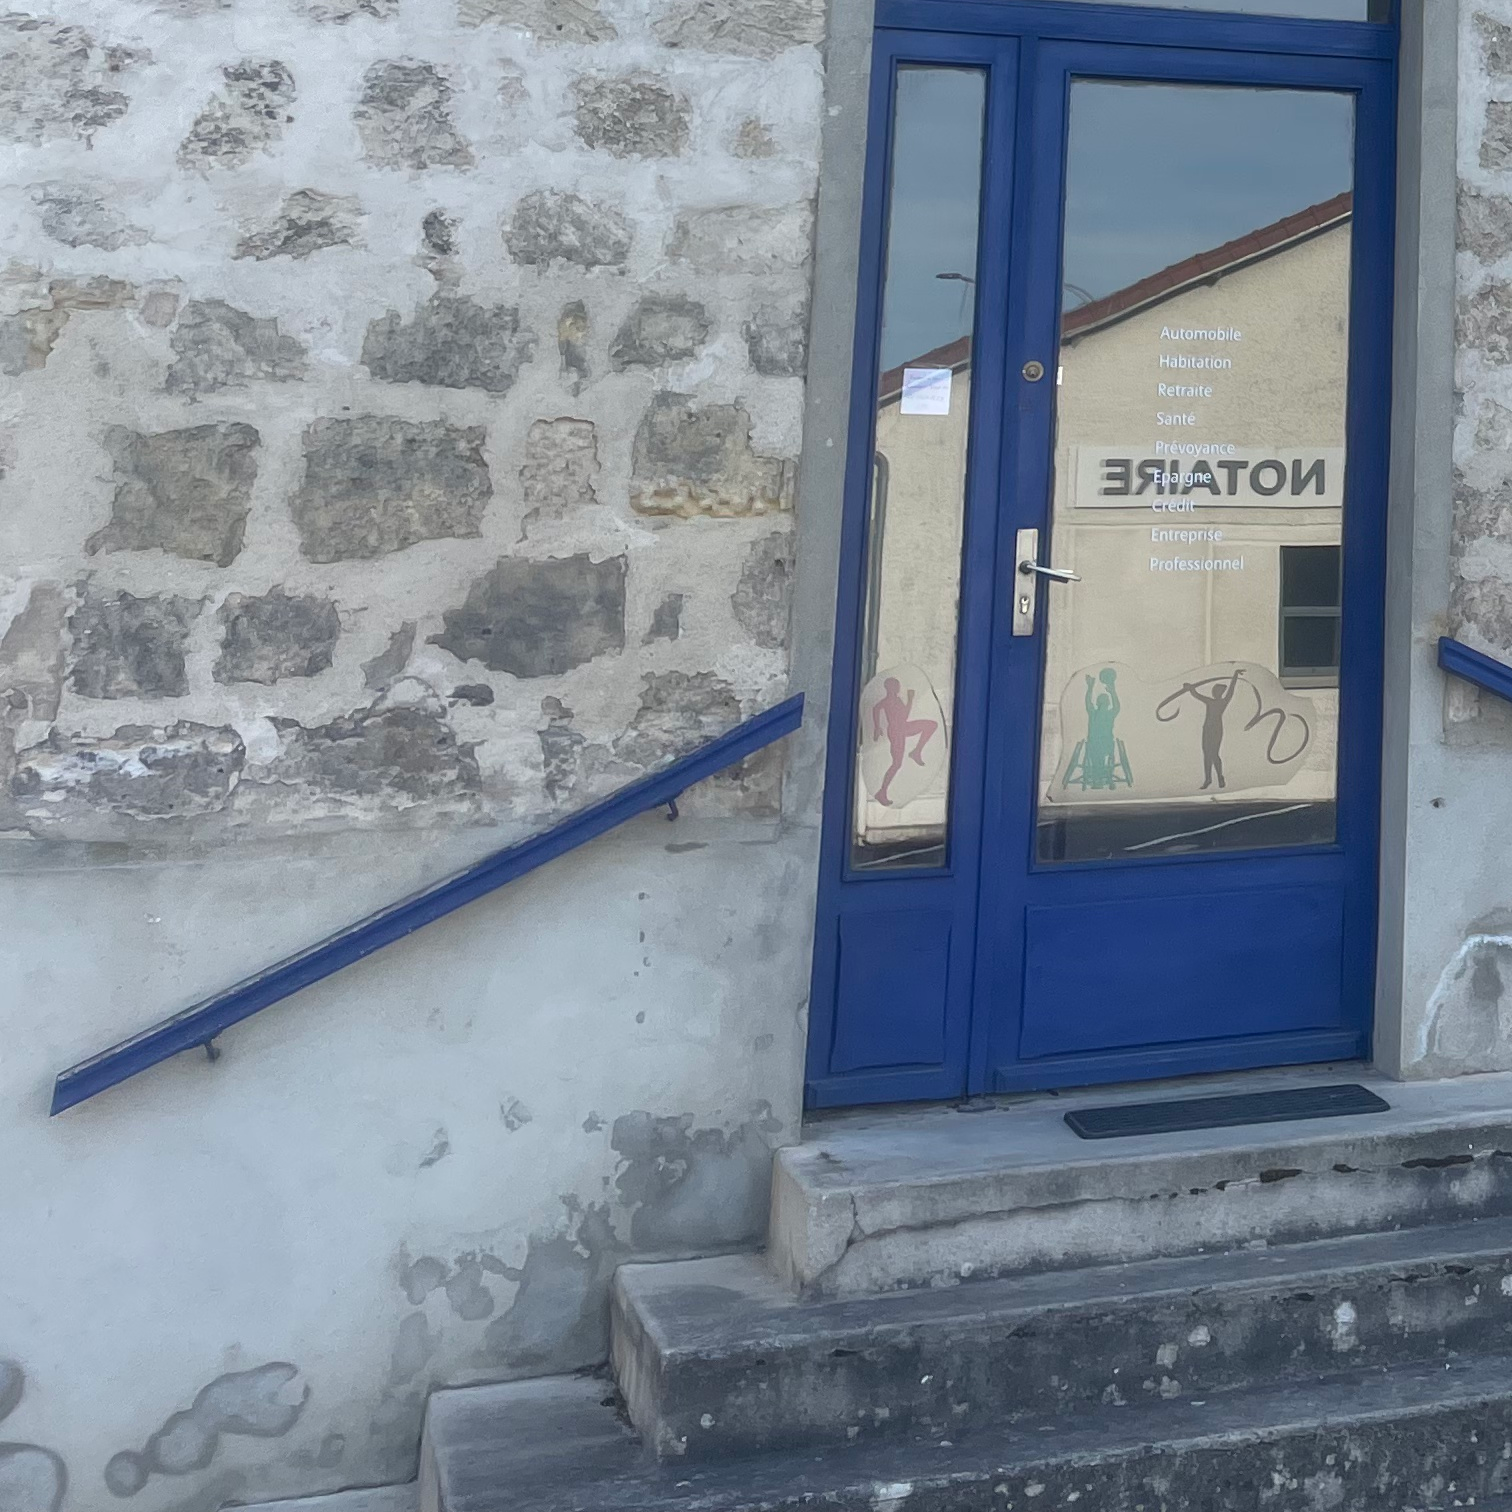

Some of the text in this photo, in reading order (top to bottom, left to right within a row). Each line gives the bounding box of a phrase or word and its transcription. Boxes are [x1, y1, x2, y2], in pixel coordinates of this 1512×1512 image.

[1160, 326, 1242, 341] Automobile
[1159, 354, 1232, 369] Habitation
[1157, 383, 1213, 397] Retraite
[1156, 411, 1196, 426] Santé
[1155, 440, 1236, 458] Prévoyance
[1153, 469, 1212, 487] Epargne
[1152, 498, 1195, 513] Crédit
[1151, 527, 1223, 544] Entreprise
[1150, 556, 1244, 572] Professionnel
